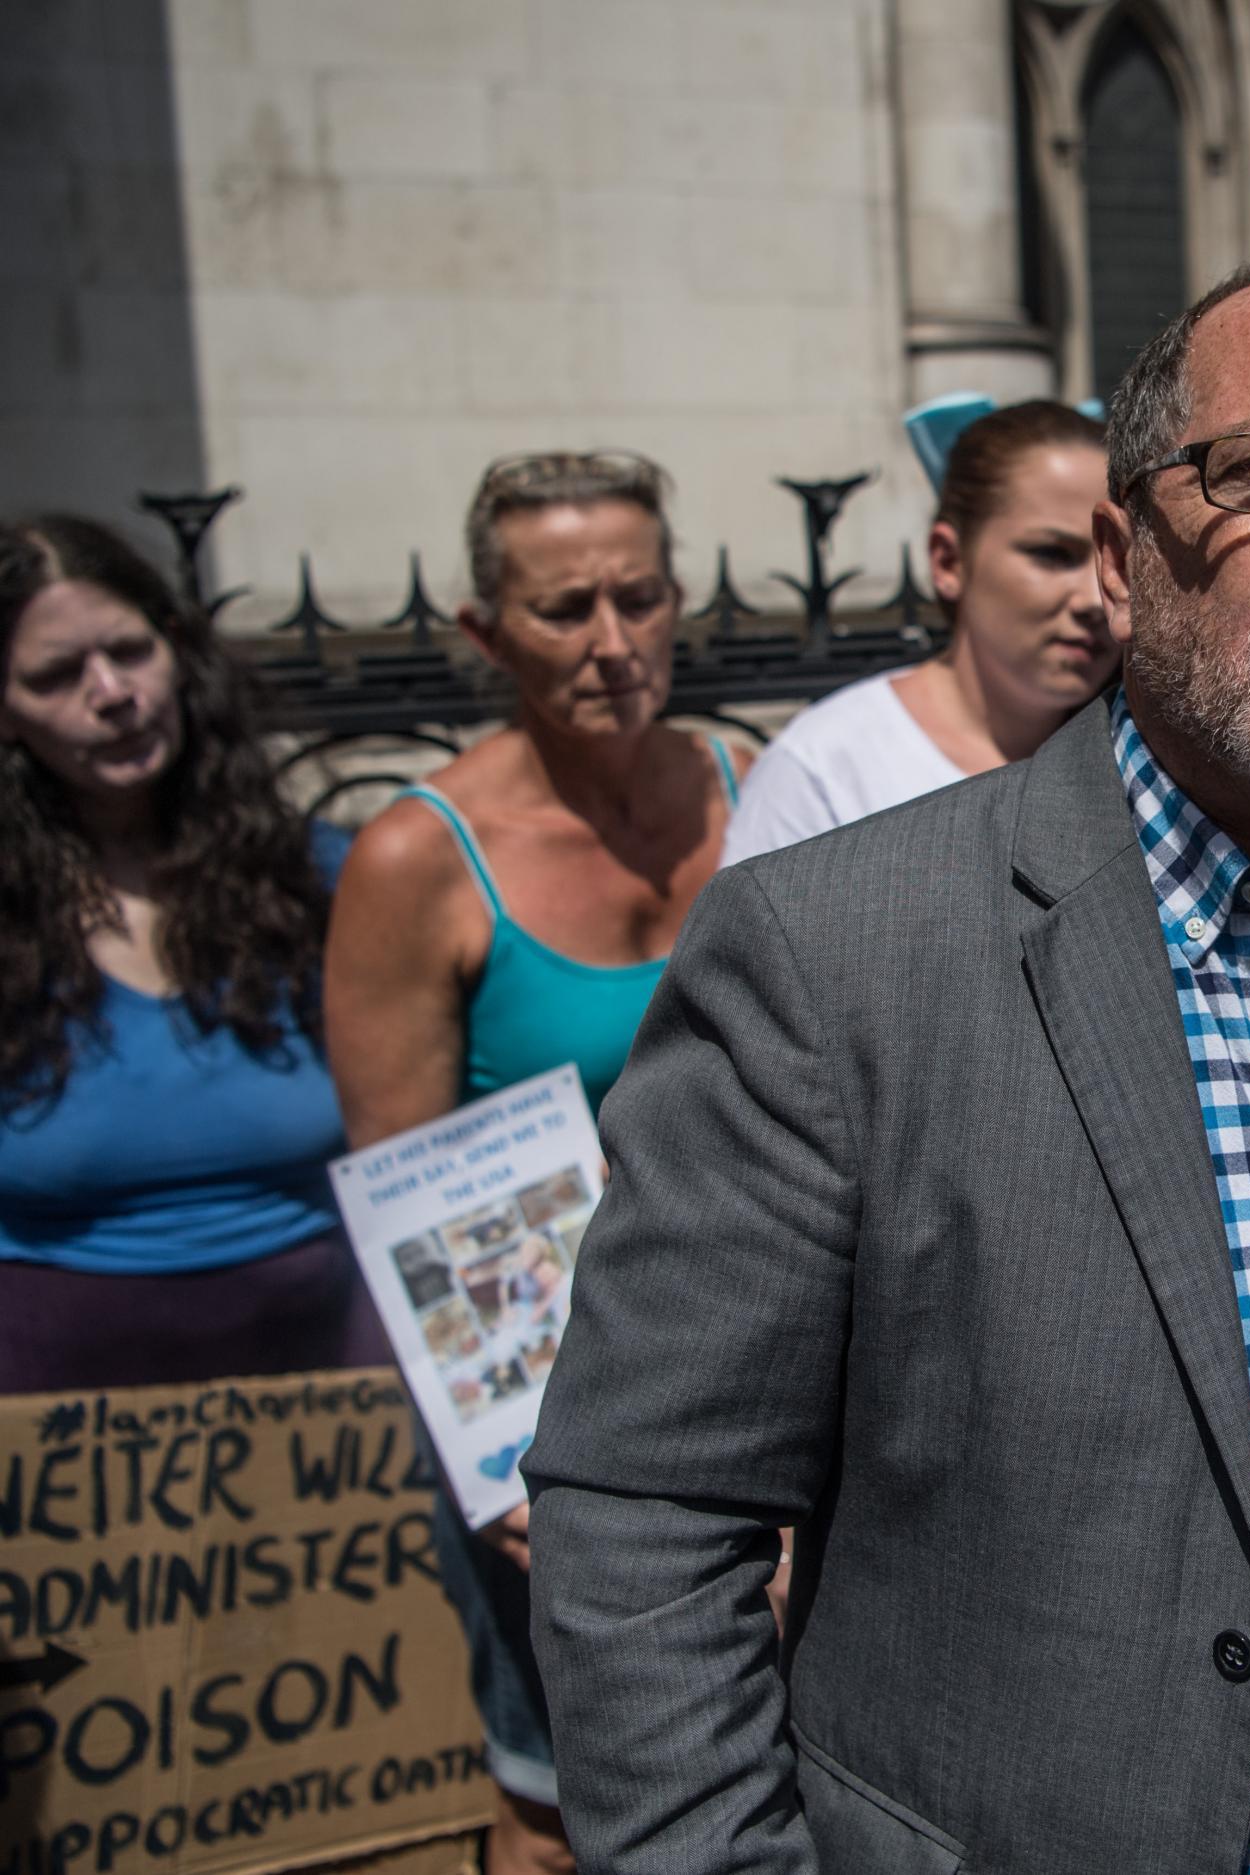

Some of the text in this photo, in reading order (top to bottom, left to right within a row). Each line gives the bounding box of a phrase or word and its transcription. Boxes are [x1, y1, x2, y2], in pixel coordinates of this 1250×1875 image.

[541, 1109, 569, 1133] TO
[0, 1510, 443, 1640] ADMINISTER
[0, 1632, 402, 1798] POISON
